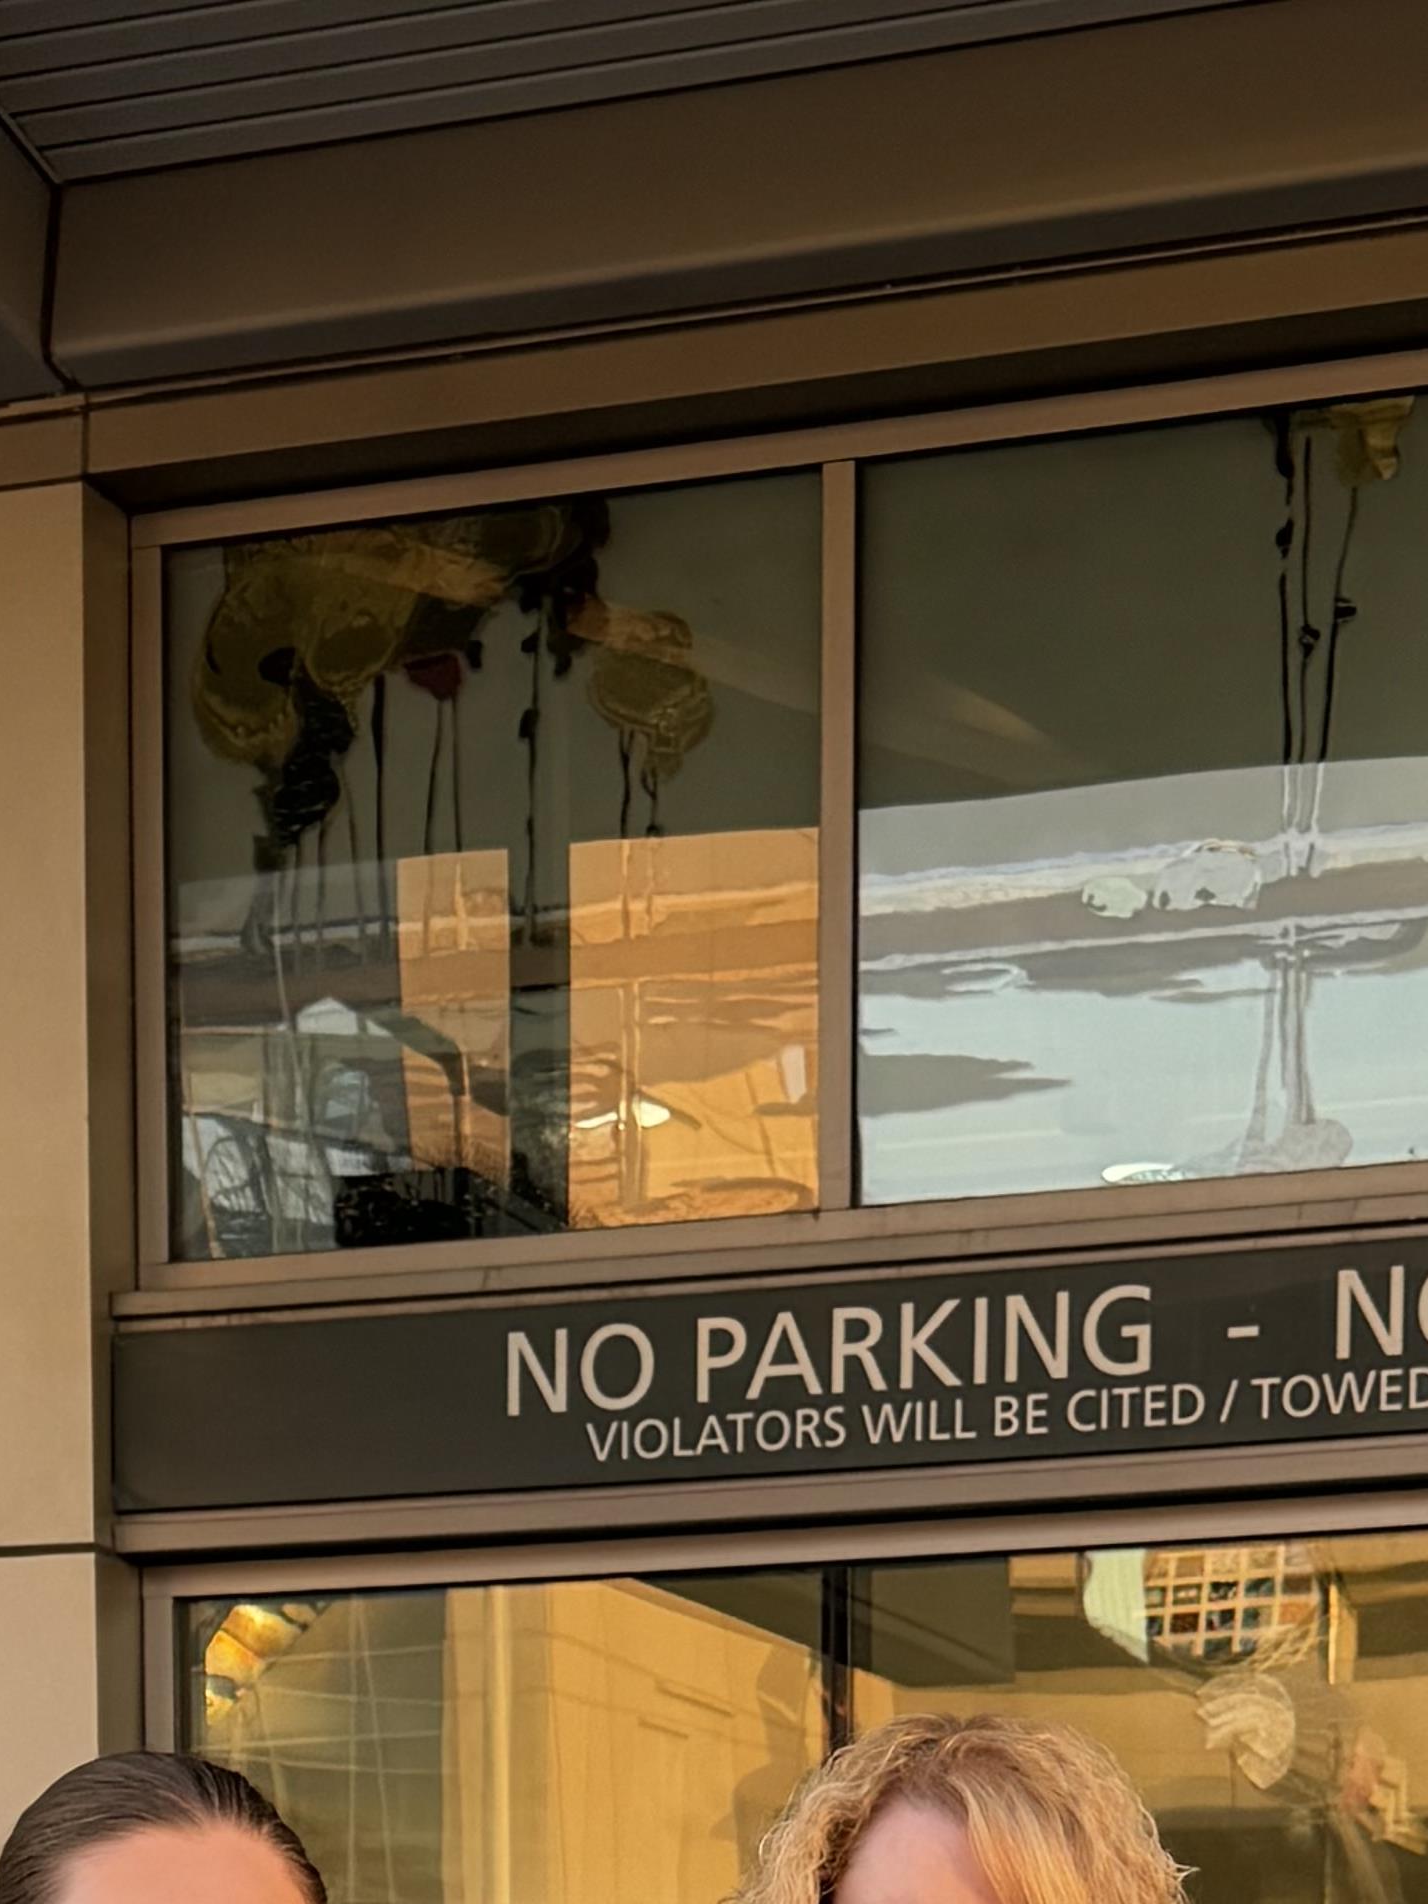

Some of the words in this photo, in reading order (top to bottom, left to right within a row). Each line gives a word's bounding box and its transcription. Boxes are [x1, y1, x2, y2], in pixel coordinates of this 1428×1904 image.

[506, 1322, 656, 1417] NO
[695, 1284, 1153, 1404] PARKING
[585, 1405, 847, 1462] VIOLATORS
[860, 1397, 978, 1445] WILL
[993, 1392, 1050, 1437] BE
[1066, 1383, 1206, 1432] CITED
[1218, 1378, 1240, 1424] /
